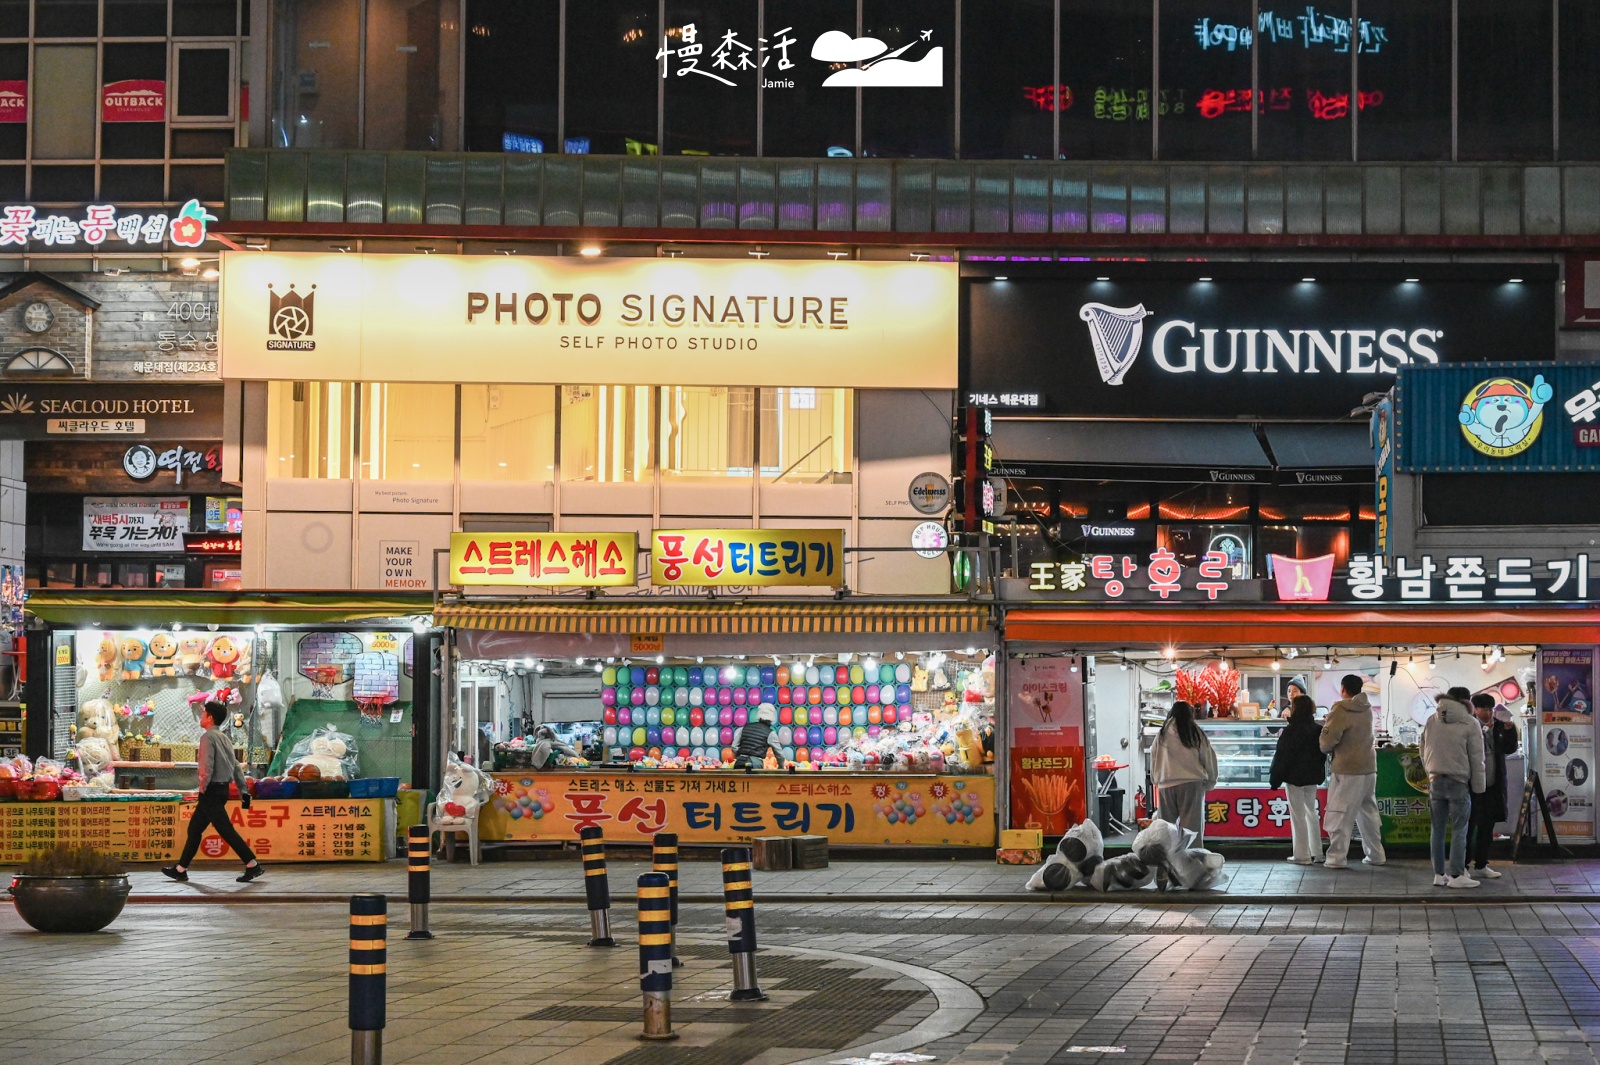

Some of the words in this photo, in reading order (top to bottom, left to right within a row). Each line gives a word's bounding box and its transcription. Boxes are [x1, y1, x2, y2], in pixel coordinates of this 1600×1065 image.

[105, 97, 163, 107] OUTBACK
[0, 206, 79, 245] 꽃피는
[80, 205, 167, 245] 동백섬
[466, 292, 601, 323] PHOTO
[620, 293, 849, 329] SIGNATURE
[268, 340, 314, 349] SIGNATURE
[560, 336, 605, 349] SELF
[614, 336, 678, 350] PHOTO
[688, 337, 758, 350] STUDIO
[1152, 319, 1439, 374] GUINNESS
[133, 361, 218, 373] 해운대점(제234호
[969, 394, 998, 405] 기네스
[1000, 394, 1039, 406] 해운대점
[40, 400, 129, 414] SEACLOUD
[132, 400, 195, 414] HOTEL
[58, 421, 110, 432] 씨클라우드
[114, 421, 135, 432] 호텔
[1579, 428, 1600, 443] GA
[1218, 473, 1256, 482] GUINNESS
[1305, 474, 1343, 482] GUINNESS
[912, 487, 947, 497] Edelweiss
[89, 526, 117, 541] 쭈욱
[1091, 526, 1135, 537] GUINNESS
[386, 547, 412, 555] MAKE
[385, 558, 412, 566] YOUR
[459, 538, 627, 579] 스트레스해소
[385, 568, 412, 577] OWN
[1347, 553, 1588, 599] 황남쫀드기
[385, 579, 427, 588] MEMORY
[1022, 757, 1073, 769] 황남쫀드기
[569, 779, 611, 792] 스트레스
[644, 779, 676, 792] 선물도
[776, 783, 852, 797] 스트레스해소
[300, 805, 372, 817] 스트레스해소
[1377, 798, 1432, 817] 애플수
